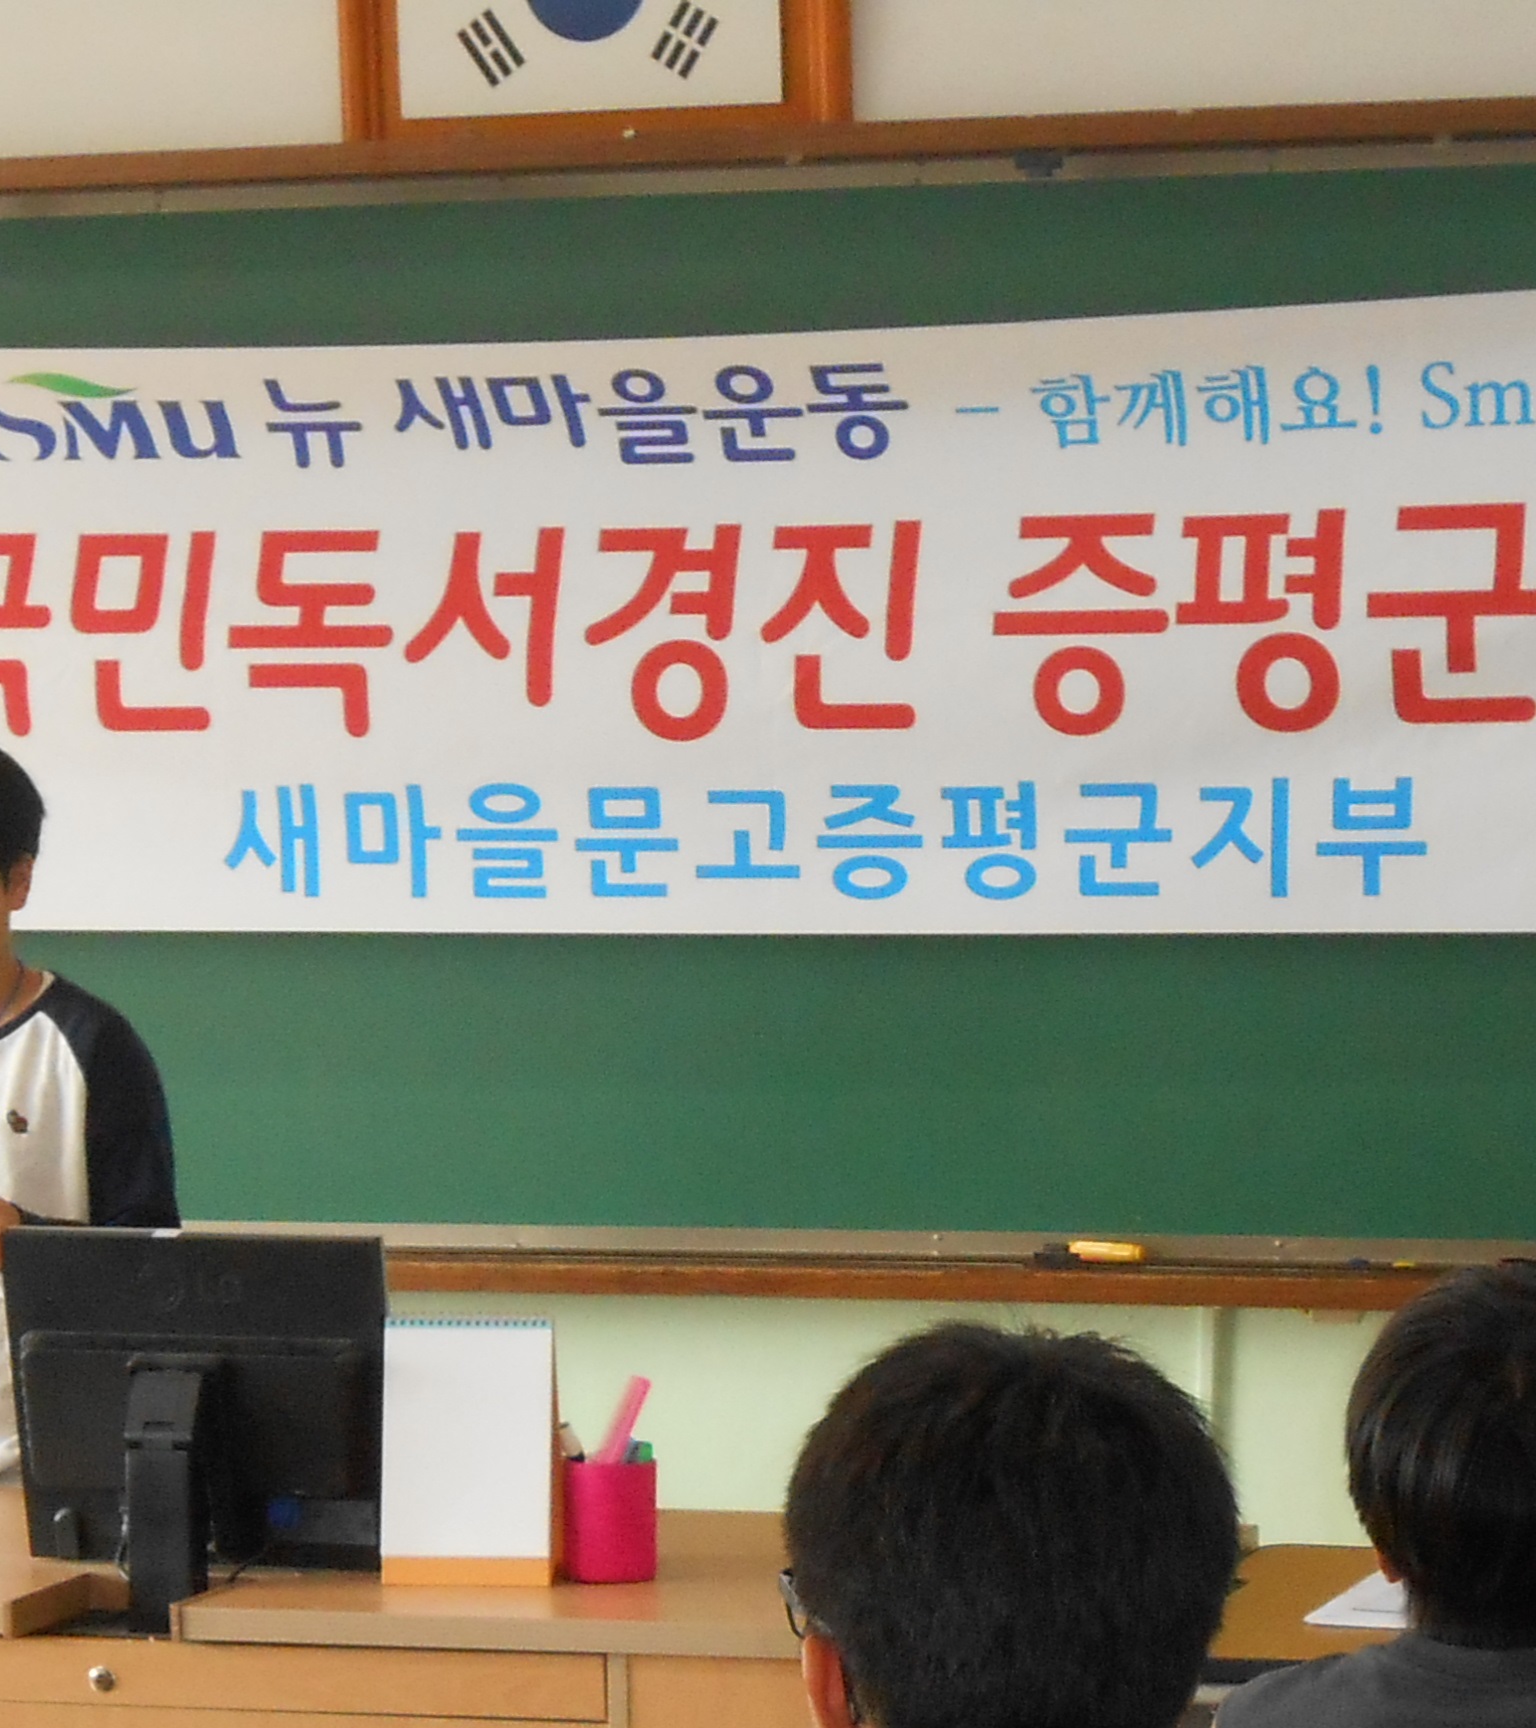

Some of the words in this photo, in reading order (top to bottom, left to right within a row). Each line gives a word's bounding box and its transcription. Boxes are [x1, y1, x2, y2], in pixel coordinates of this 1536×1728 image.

[265, 378, 362, 468] 뉴
[393, 362, 909, 467] 새마을운동
[1029, 362, 1385, 450] 함께해요!
[224, 774, 1430, 903] 새마을문고증평군지부
